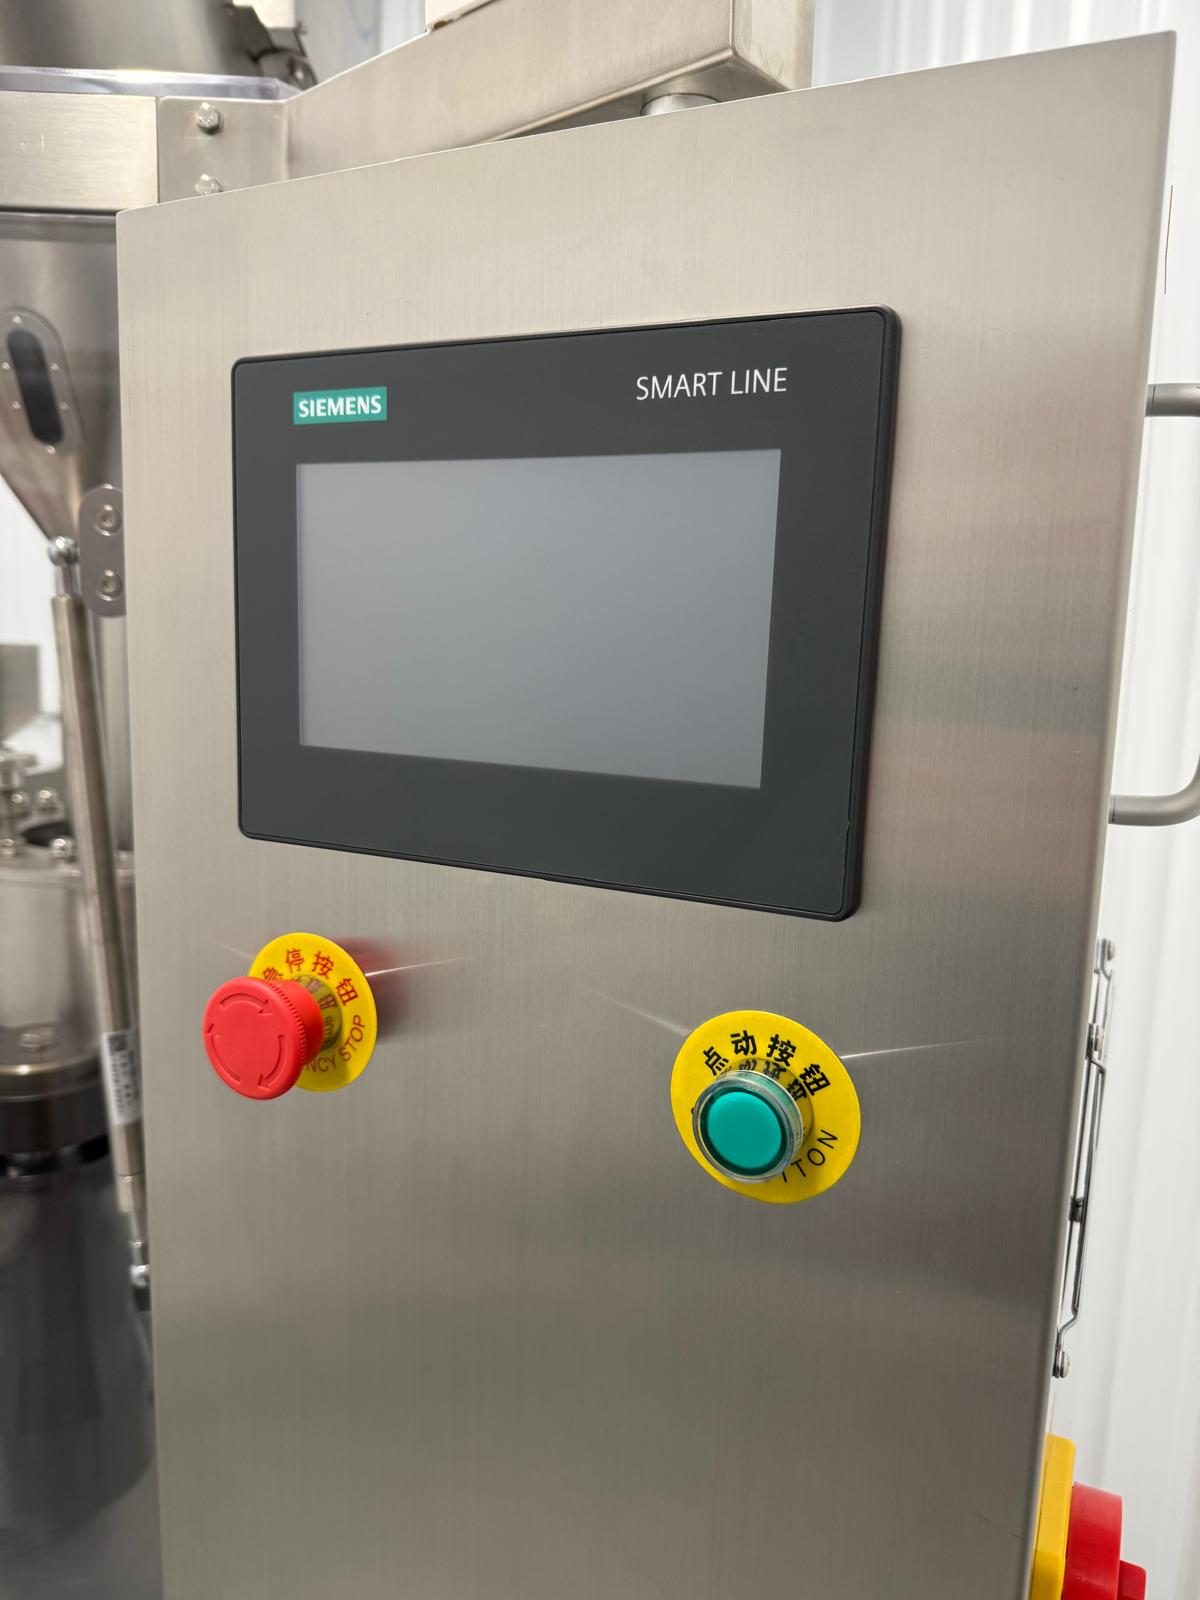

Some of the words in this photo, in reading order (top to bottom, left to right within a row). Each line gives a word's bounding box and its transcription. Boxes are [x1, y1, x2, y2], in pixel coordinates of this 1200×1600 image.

[636, 371, 722, 400] SMART
[731, 366, 788, 396] LINE
[298, 394, 382, 419] SIEMENS
[338, 1014, 366, 1062] STOP
[702, 1029, 831, 1096] 点动按钮
